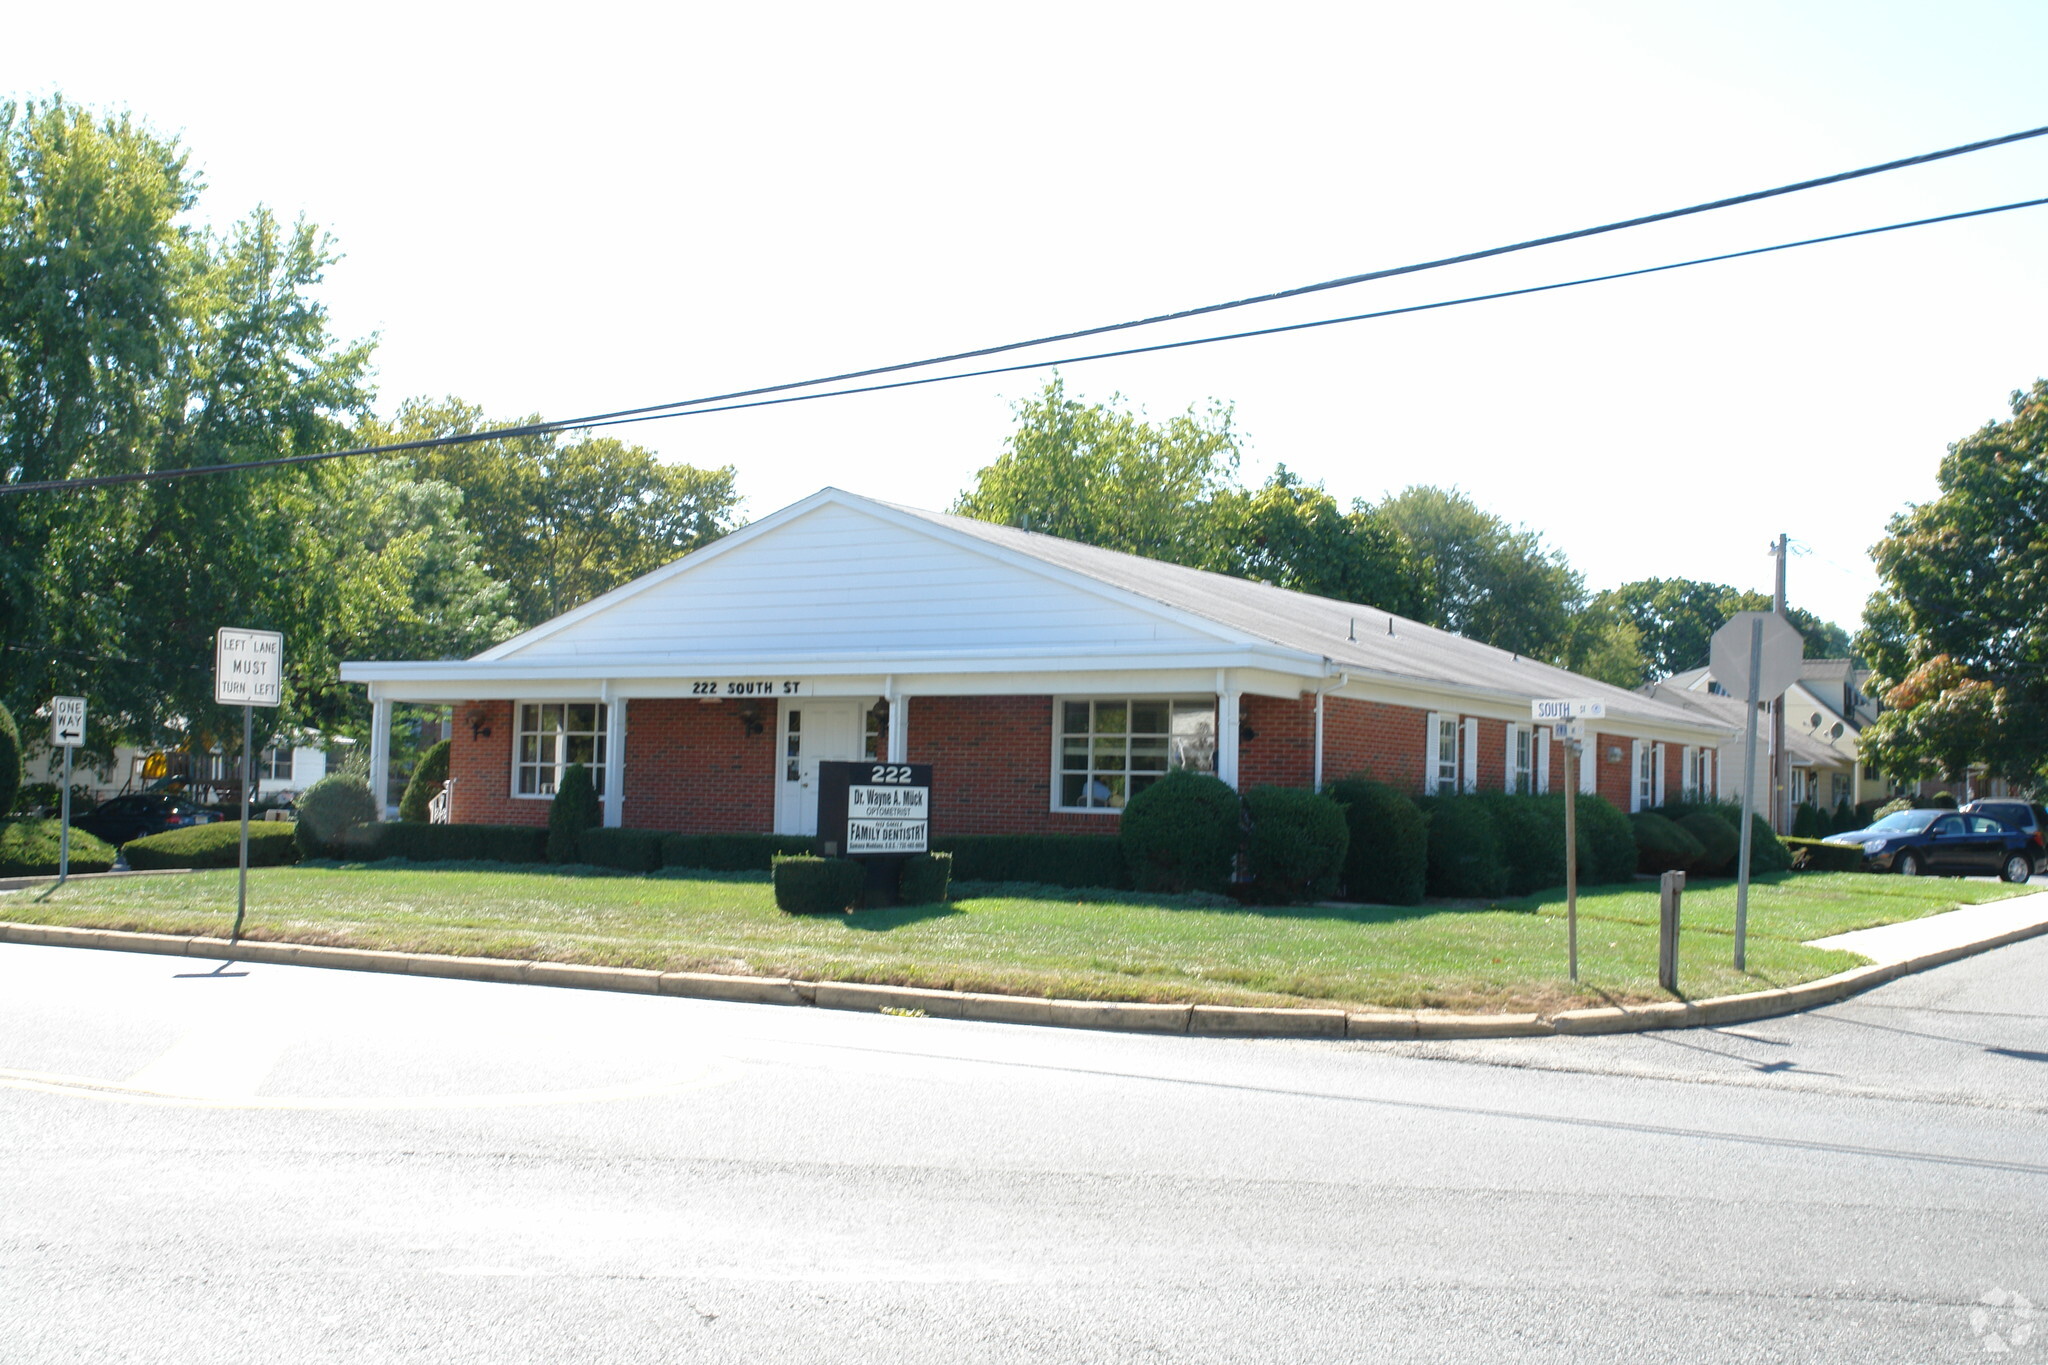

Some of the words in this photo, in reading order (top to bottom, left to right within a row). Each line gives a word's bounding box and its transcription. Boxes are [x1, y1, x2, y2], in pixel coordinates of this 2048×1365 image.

[223, 638, 246, 652] LEFT
[253, 640, 277, 655] LANE
[232, 659, 268, 676] MUST
[222, 681, 246, 694] TURN
[254, 683, 275, 696] LEFT
[692, 681, 718, 695] 222
[727, 681, 773, 695] SOUTH
[783, 680, 801, 694] ST
[59, 701, 82, 714] ONE
[1538, 701, 1570, 717] SOUTH
[58, 714, 82, 727] WAY
[871, 765, 912, 784] 222
[854, 788, 865, 805] Dr.
[867, 789, 891, 807] Wayne
[893, 790, 901, 805] A.
[866, 807, 911, 816] OPTOMETRIST
[851, 823, 881, 841] FAMILY
[883, 823, 925, 841] DENTISTRY
